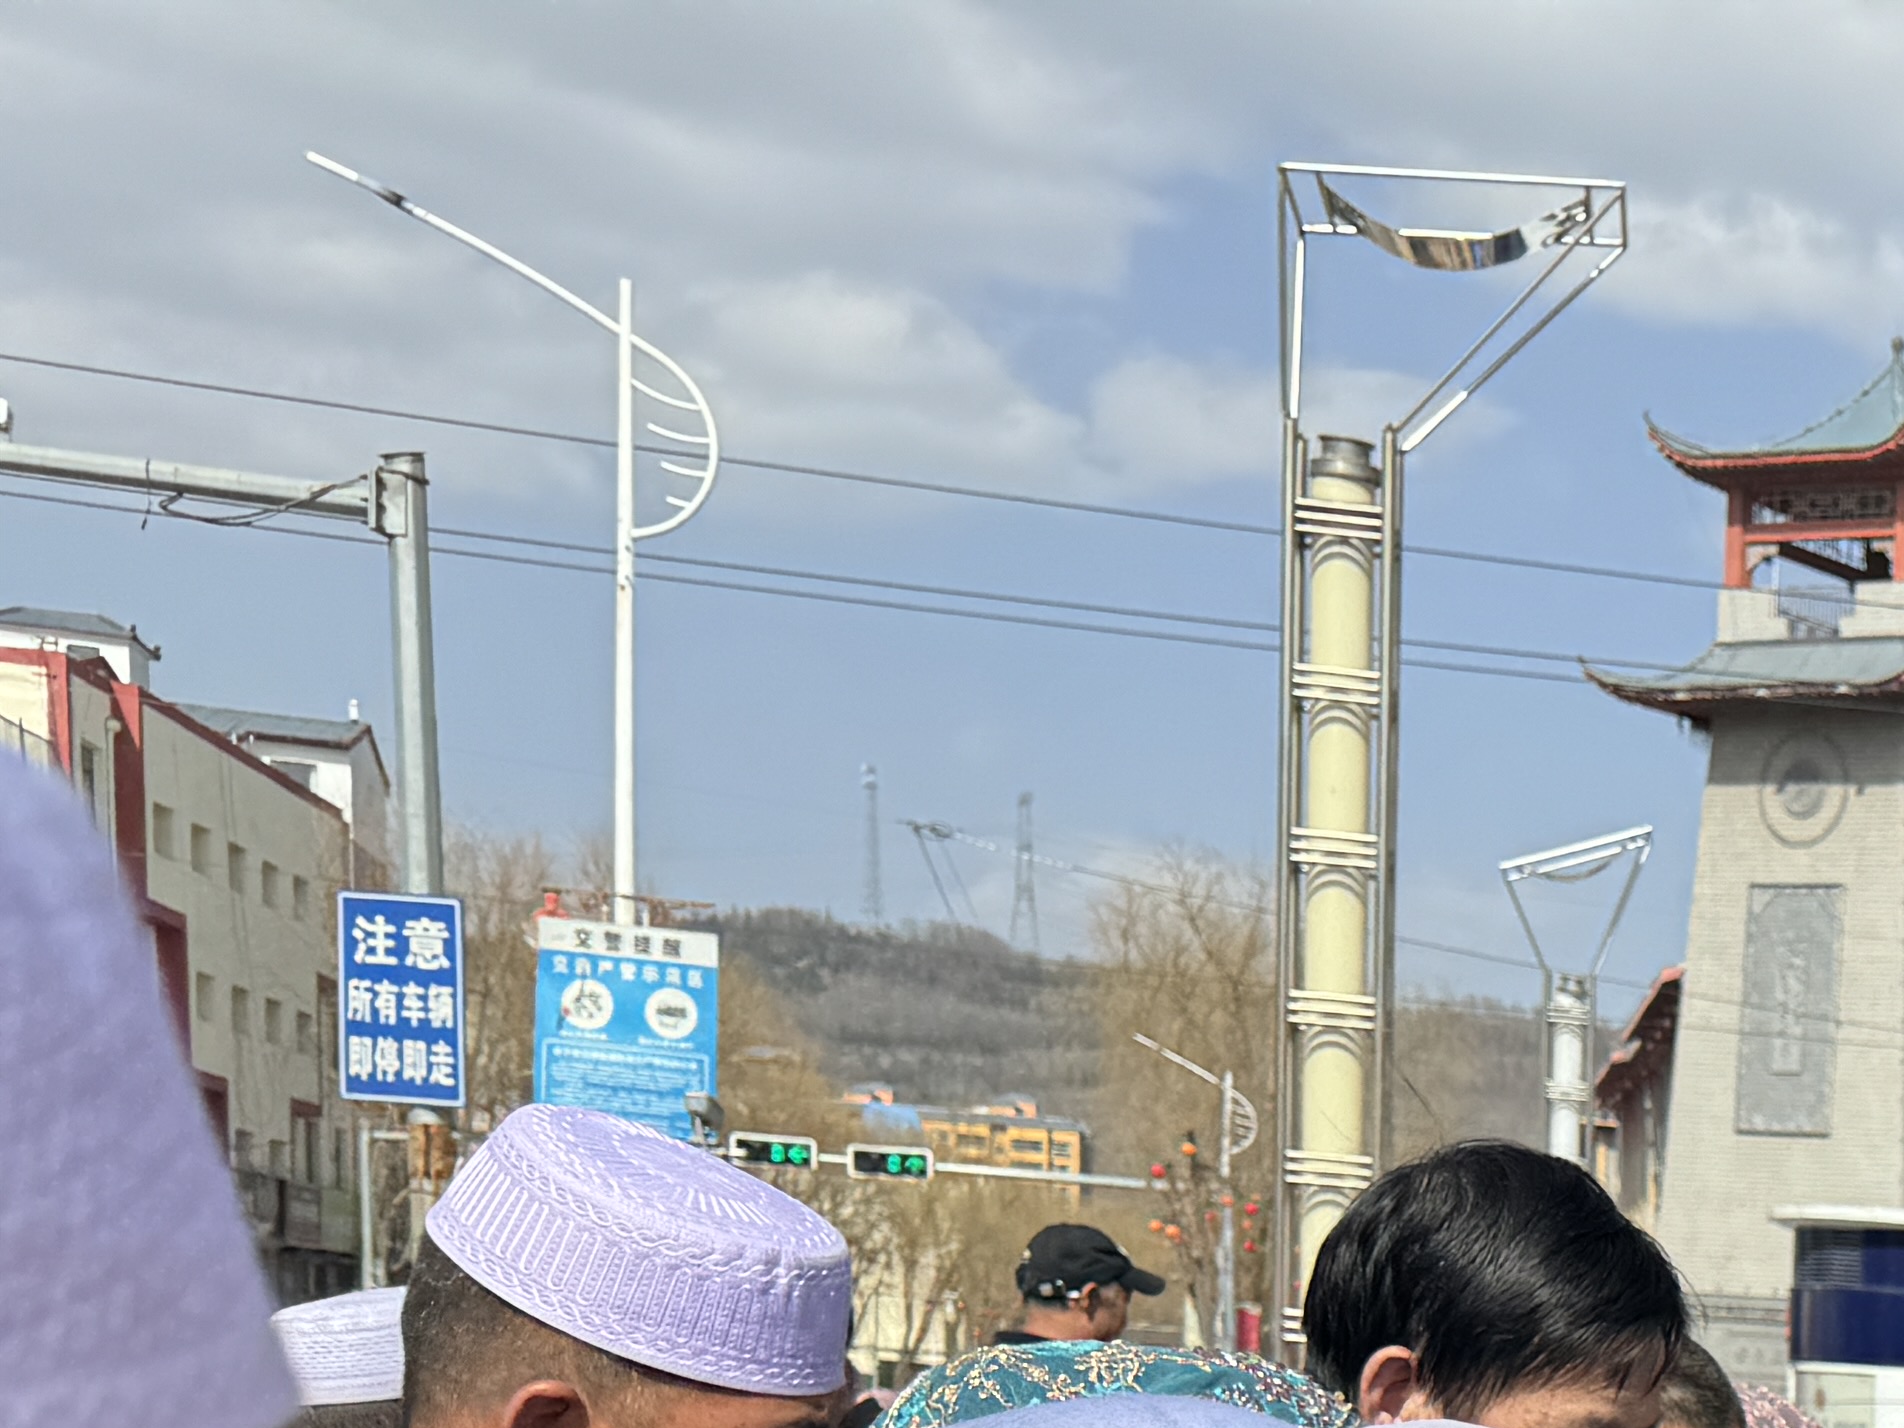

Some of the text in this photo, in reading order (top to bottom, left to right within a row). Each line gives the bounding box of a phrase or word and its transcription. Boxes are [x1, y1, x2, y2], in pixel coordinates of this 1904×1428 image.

[352, 915, 451, 970] 注意
[347, 979, 455, 1029] 所有车辆
[348, 1036, 456, 1087] 即停即走
